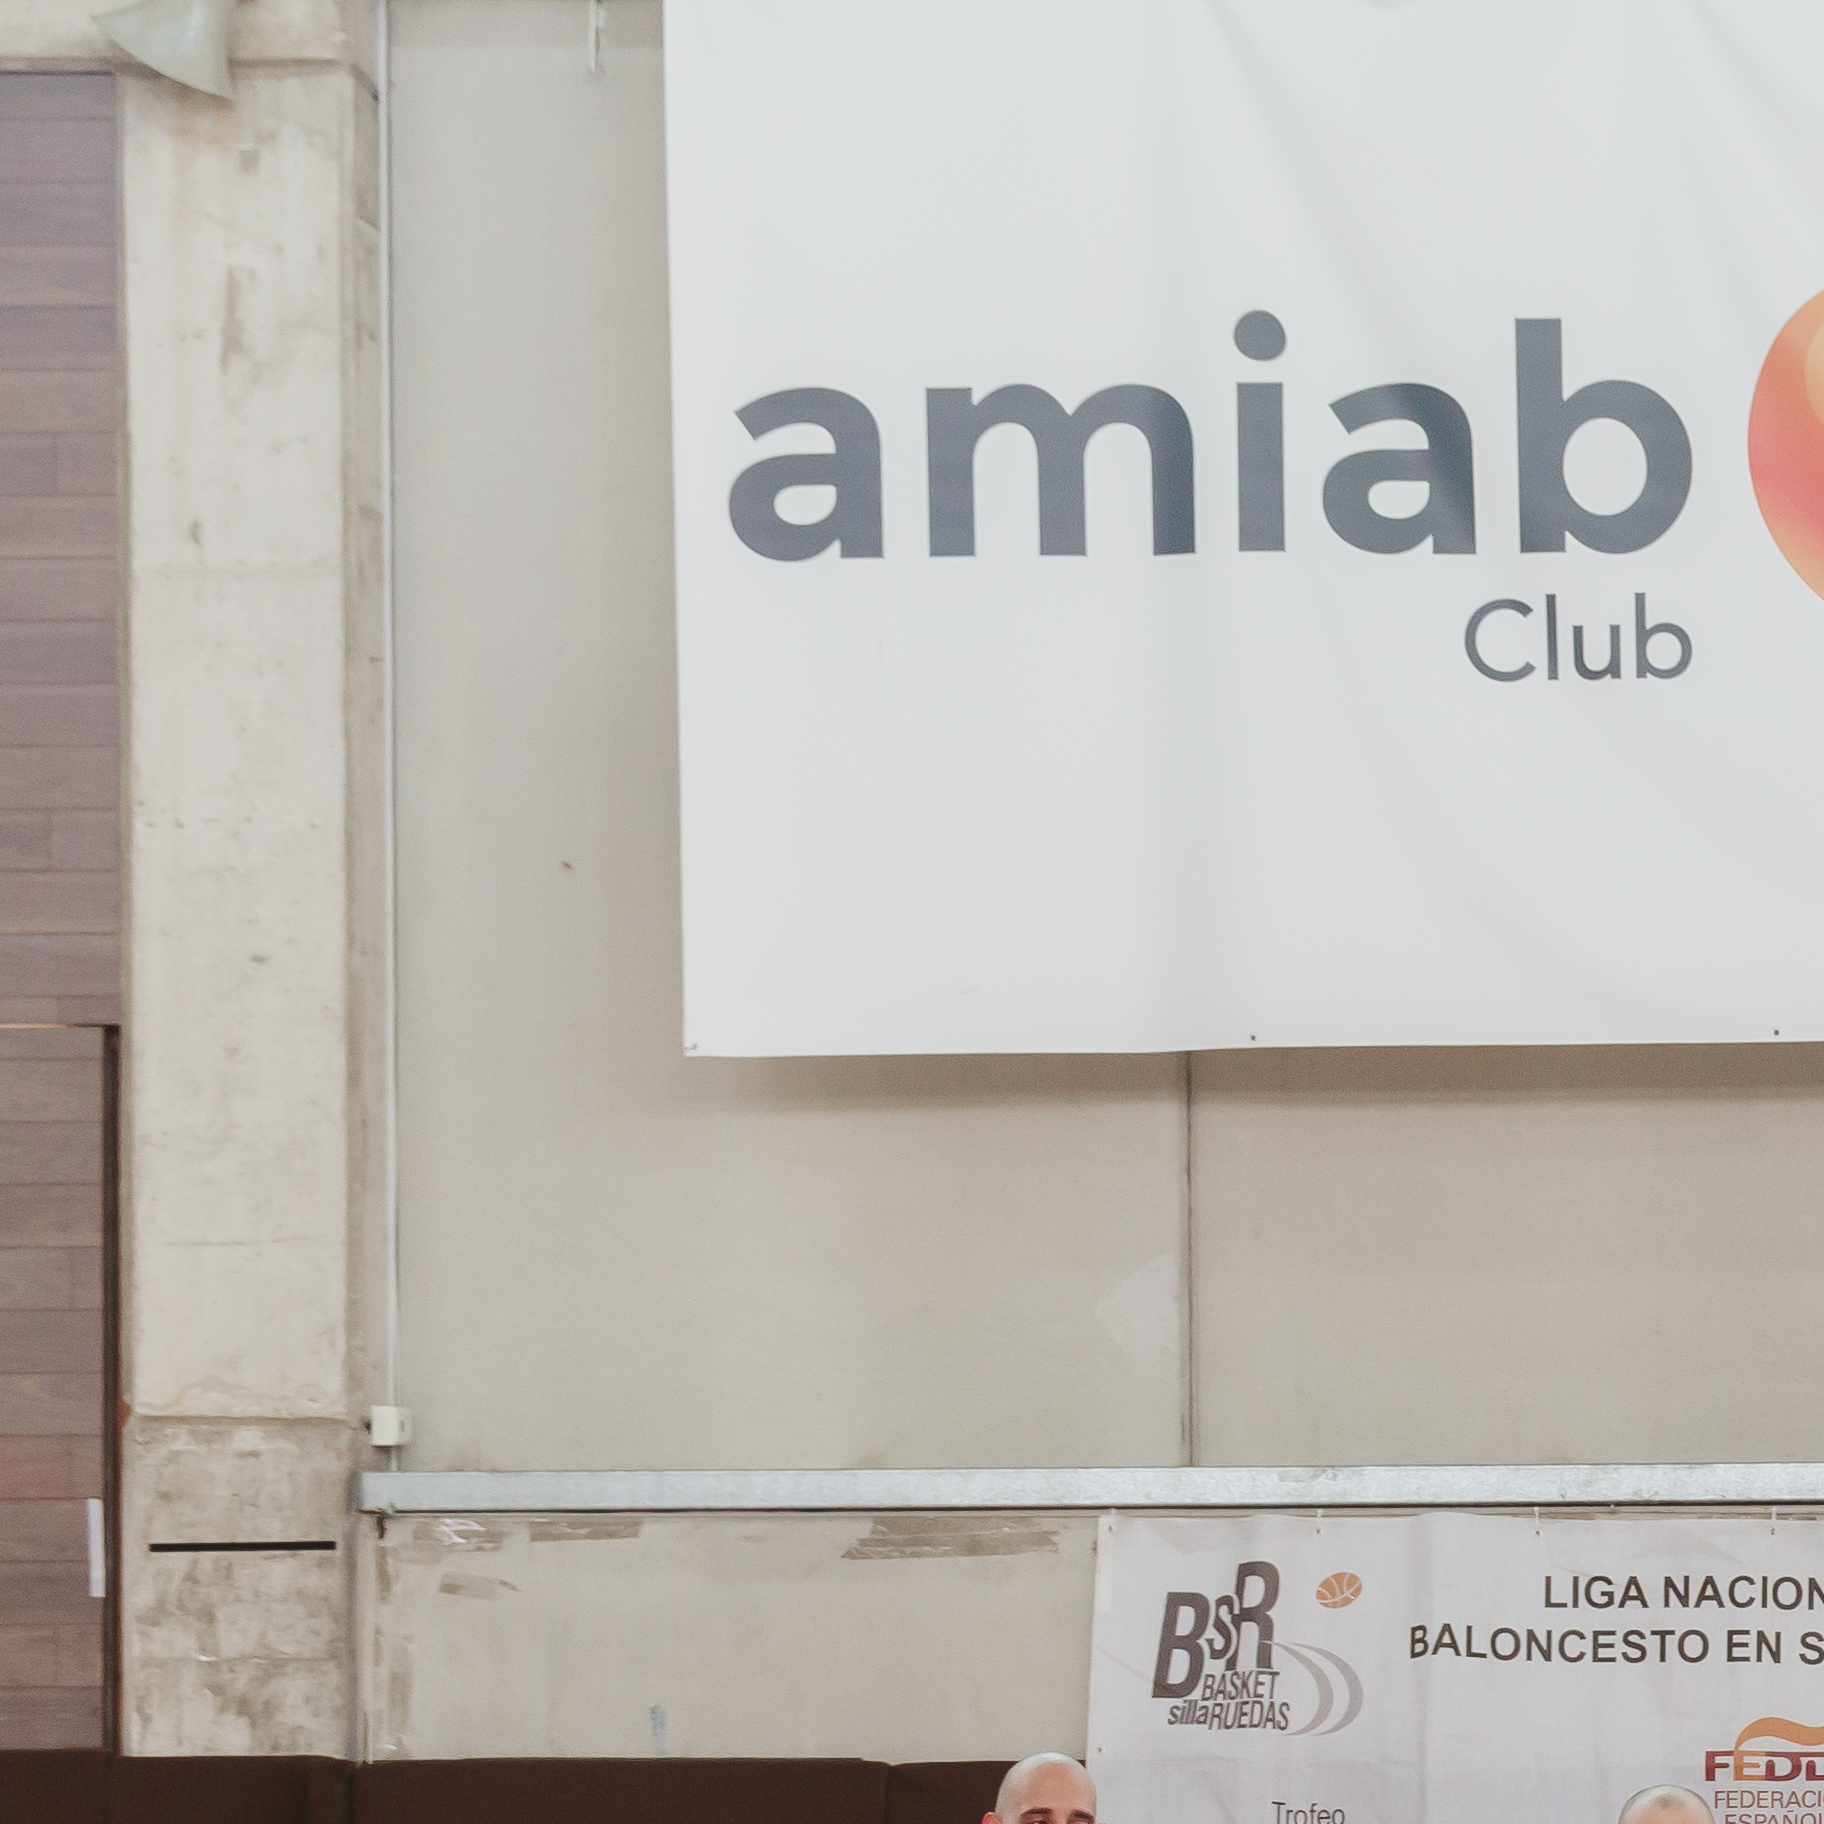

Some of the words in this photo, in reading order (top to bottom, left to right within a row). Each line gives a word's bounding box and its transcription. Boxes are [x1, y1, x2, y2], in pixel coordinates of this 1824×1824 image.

[727, 309, 1693, 563] amiab
[1464, 592, 1693, 684] Club
[1543, 1574, 1650, 1610] LIGA
[1151, 1560, 1281, 1699] BSR
[1409, 1623, 1710, 1665] BALONCESTO
[1724, 1628, 1782, 1665] EN
[1200, 1670, 1281, 1702] BASKET
